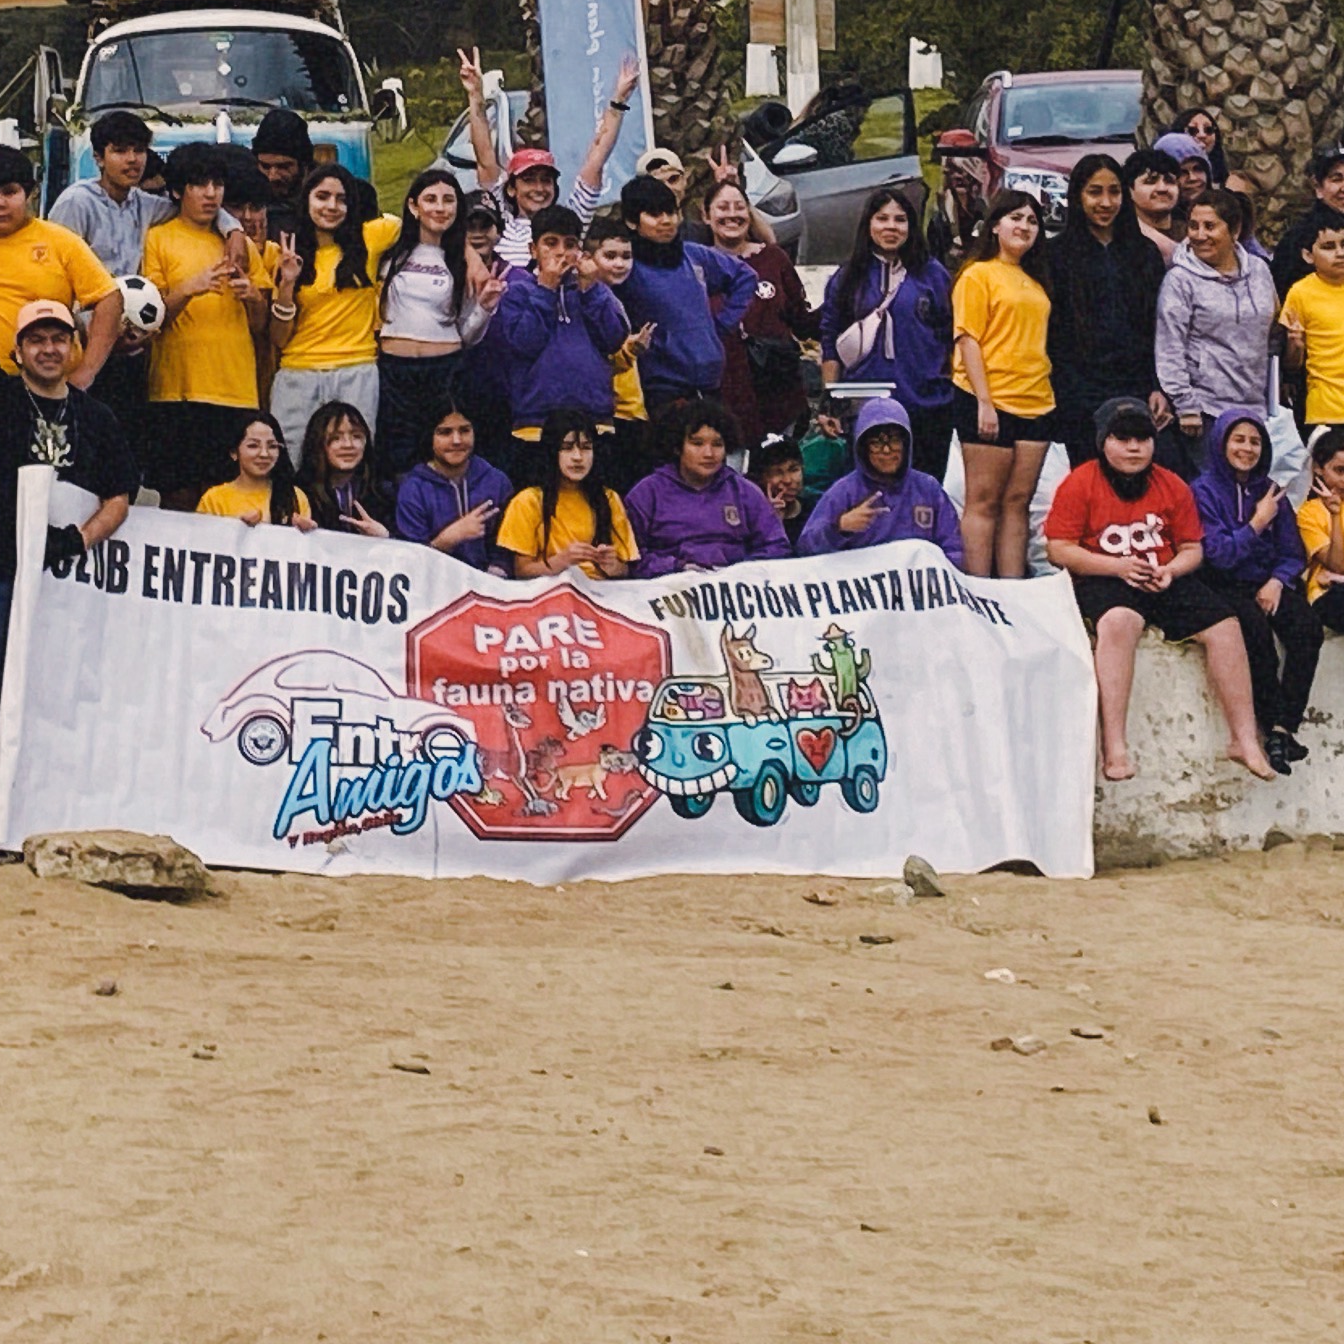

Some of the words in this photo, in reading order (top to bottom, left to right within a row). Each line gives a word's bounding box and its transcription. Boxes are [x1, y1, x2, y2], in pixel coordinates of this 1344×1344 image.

[142, 543, 411, 625] ENTREAMIGOS
[647, 579, 804, 622] FUNDACIÓN
[805, 569, 906, 618] PLANTA
[473, 613, 605, 654] PARE
[499, 655, 550, 677] por
[560, 646, 591, 669] la
[432, 677, 537, 707] fauna
[547, 672, 656, 705] nativa
[273, 738, 484, 840] Amigos
